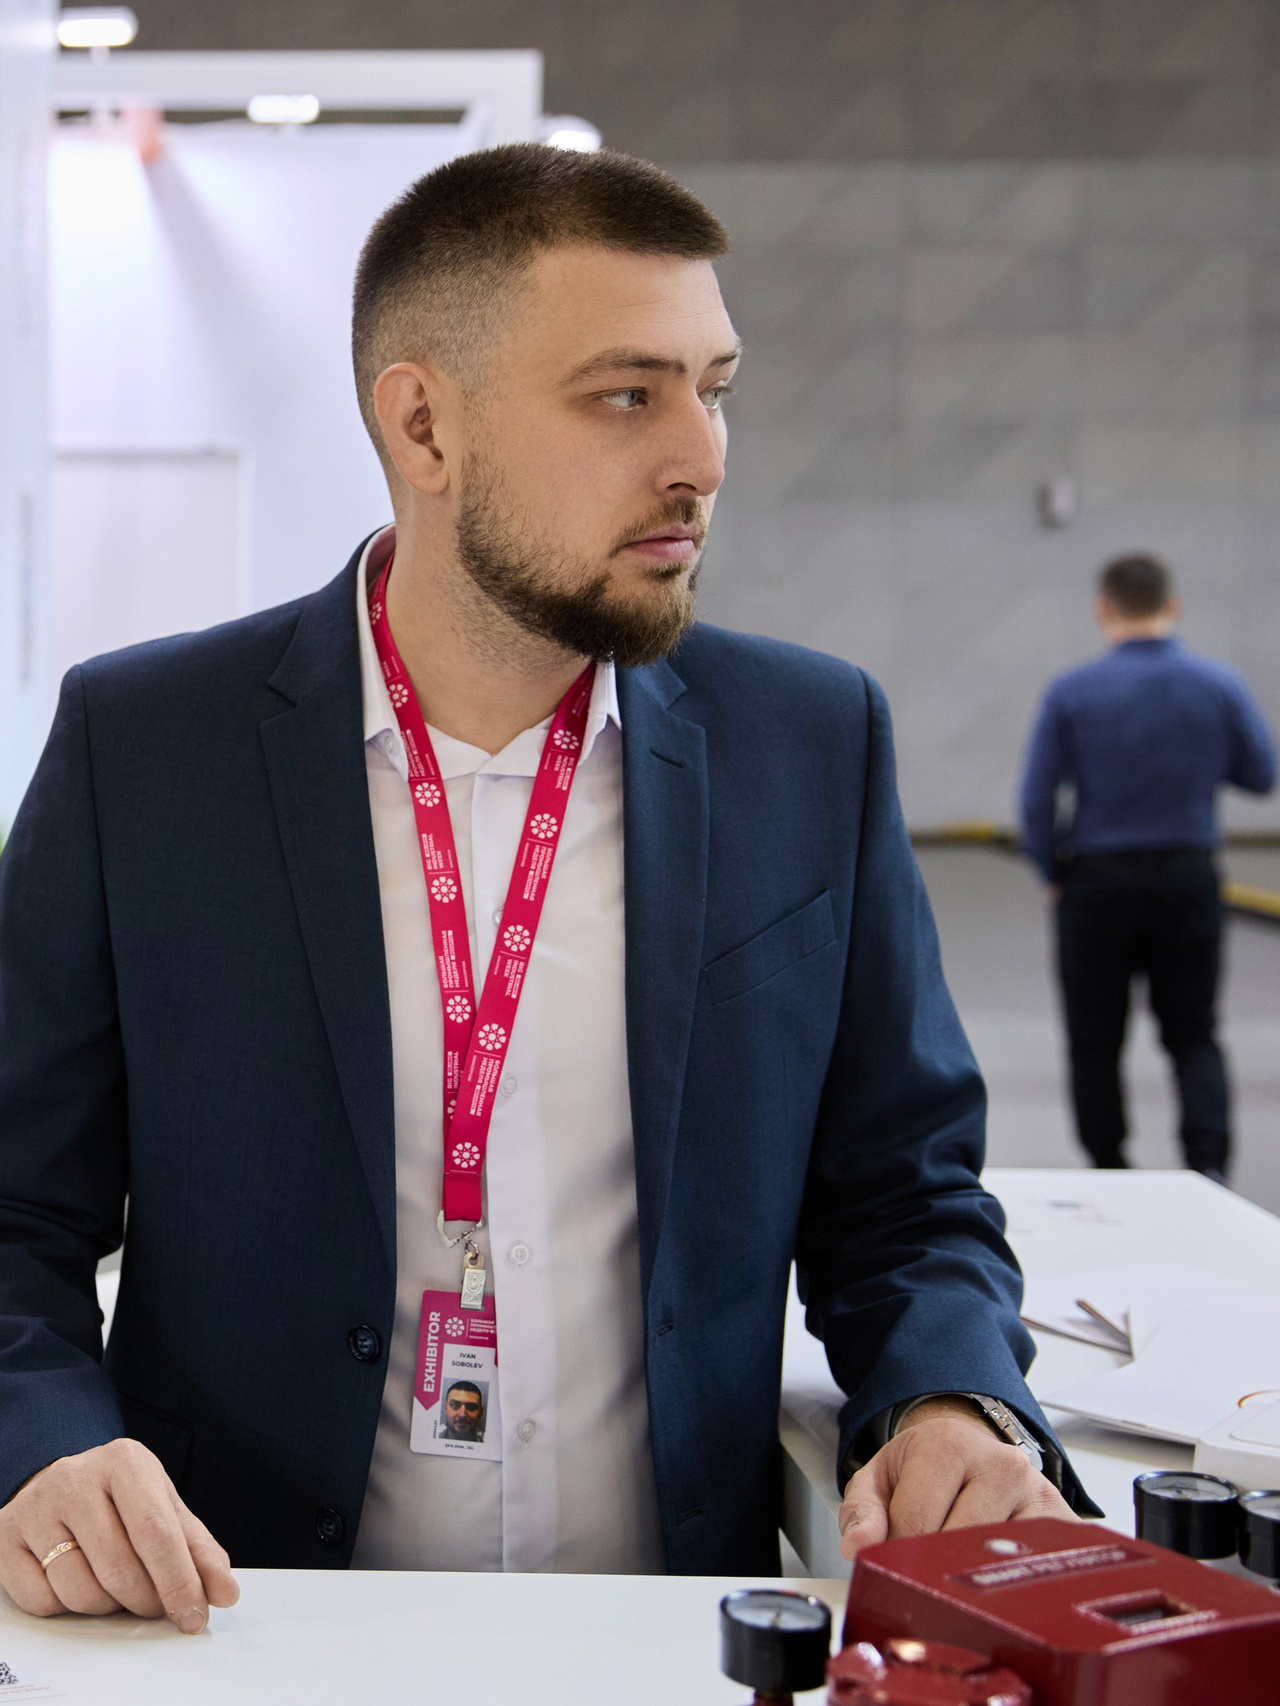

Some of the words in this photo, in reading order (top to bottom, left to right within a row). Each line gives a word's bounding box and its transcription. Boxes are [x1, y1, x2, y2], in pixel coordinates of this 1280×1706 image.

[439, 955, 448, 988] БОЛЬШАЯ
[441, 930, 454, 988] ПРОМЫШЛЕННАЯ
[451, 961, 460, 988] НЕДЕЛЯ
[503, 959, 513, 978] WEEK
[517, 961, 525, 973] BIG
[505, 959, 519, 996] INDUSTRIAL
[477, 1057, 487, 1084] НЕДЕЛЯ
[488, 1060, 500, 1093] БОЛЬШАЯ
[476, 1058, 494, 1117] ПРОМЫШЛЕННАЯ
[423, 1311, 441, 1393] EXHIBITOR
[451, 1360, 483, 1368] SOBOLEV
